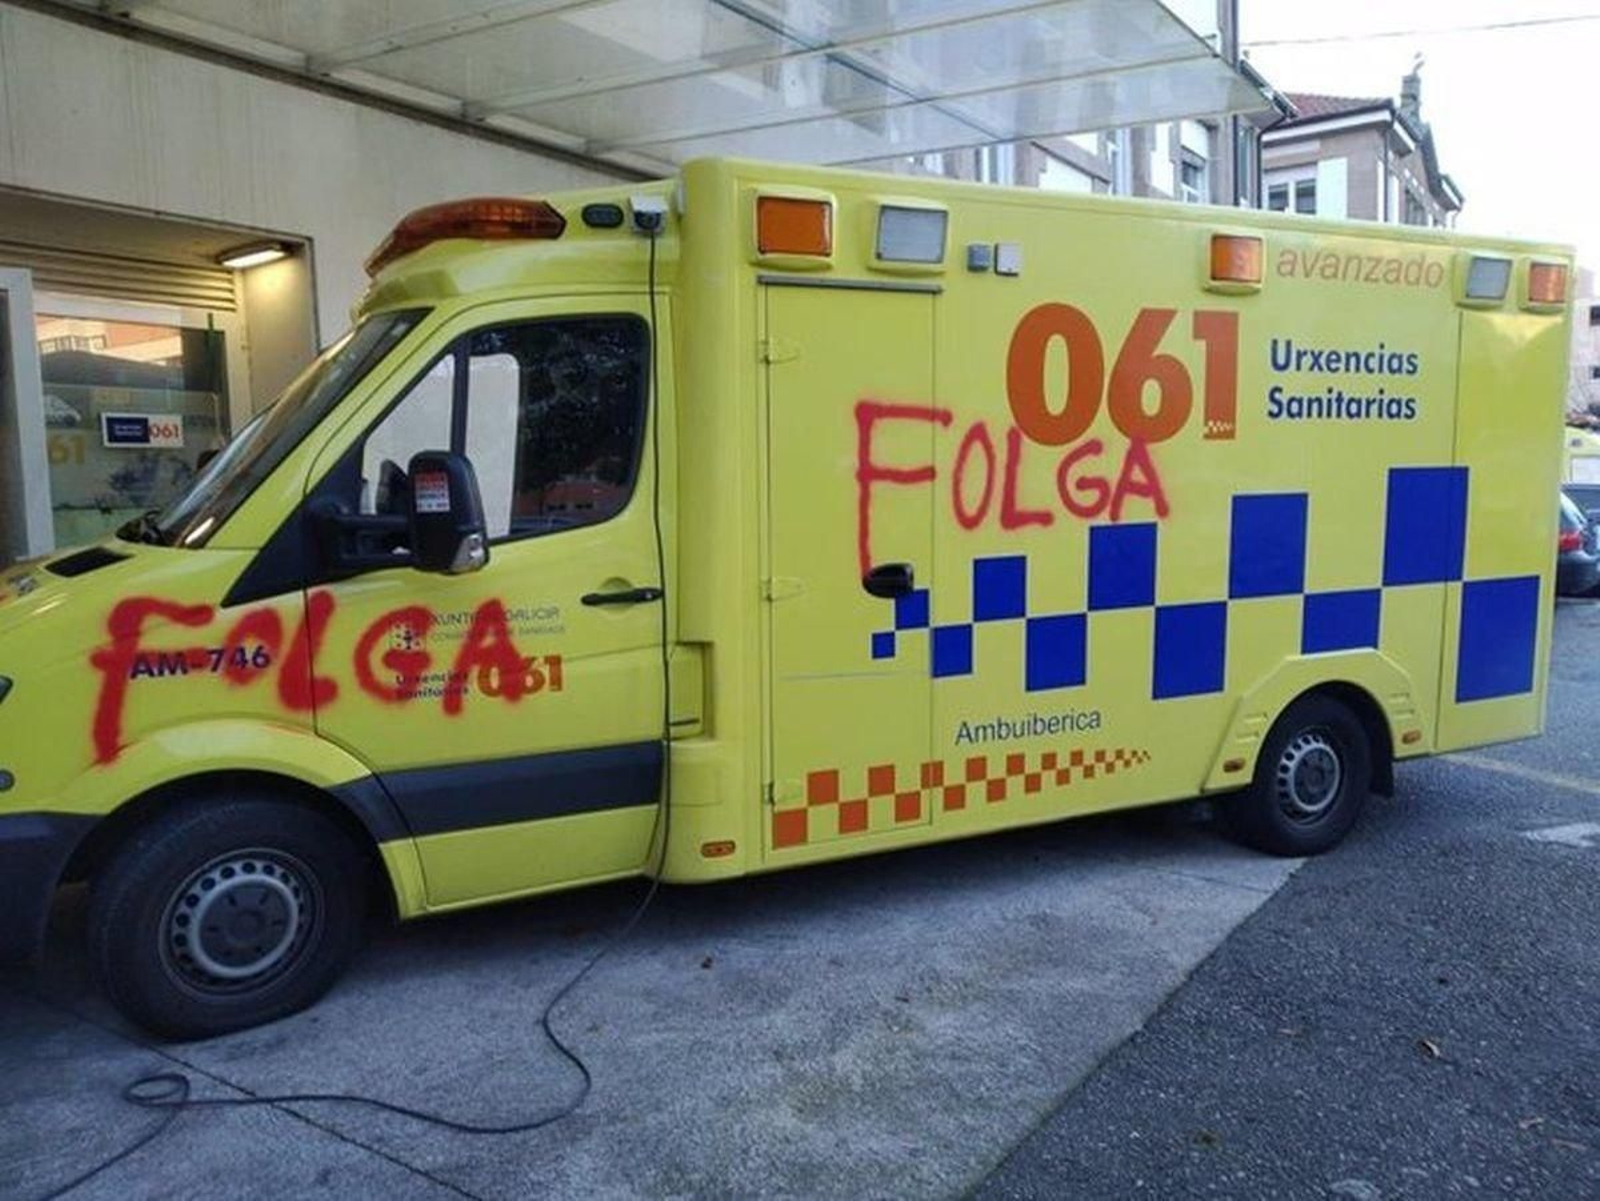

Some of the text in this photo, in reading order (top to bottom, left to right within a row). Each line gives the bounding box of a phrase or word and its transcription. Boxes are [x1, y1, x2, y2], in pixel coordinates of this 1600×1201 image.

[1276, 249, 1445, 289] avanzado
[1006, 302, 1239, 447] 061
[1270, 337, 1419, 376] Urxencias
[1267, 386, 1417, 420] Sanitarias
[148, 423, 179, 438] 061
[854, 400, 1170, 580] FOLGA
[91, 587, 524, 765] FOLGA
[954, 707, 1101, 746] Ambuiberica
